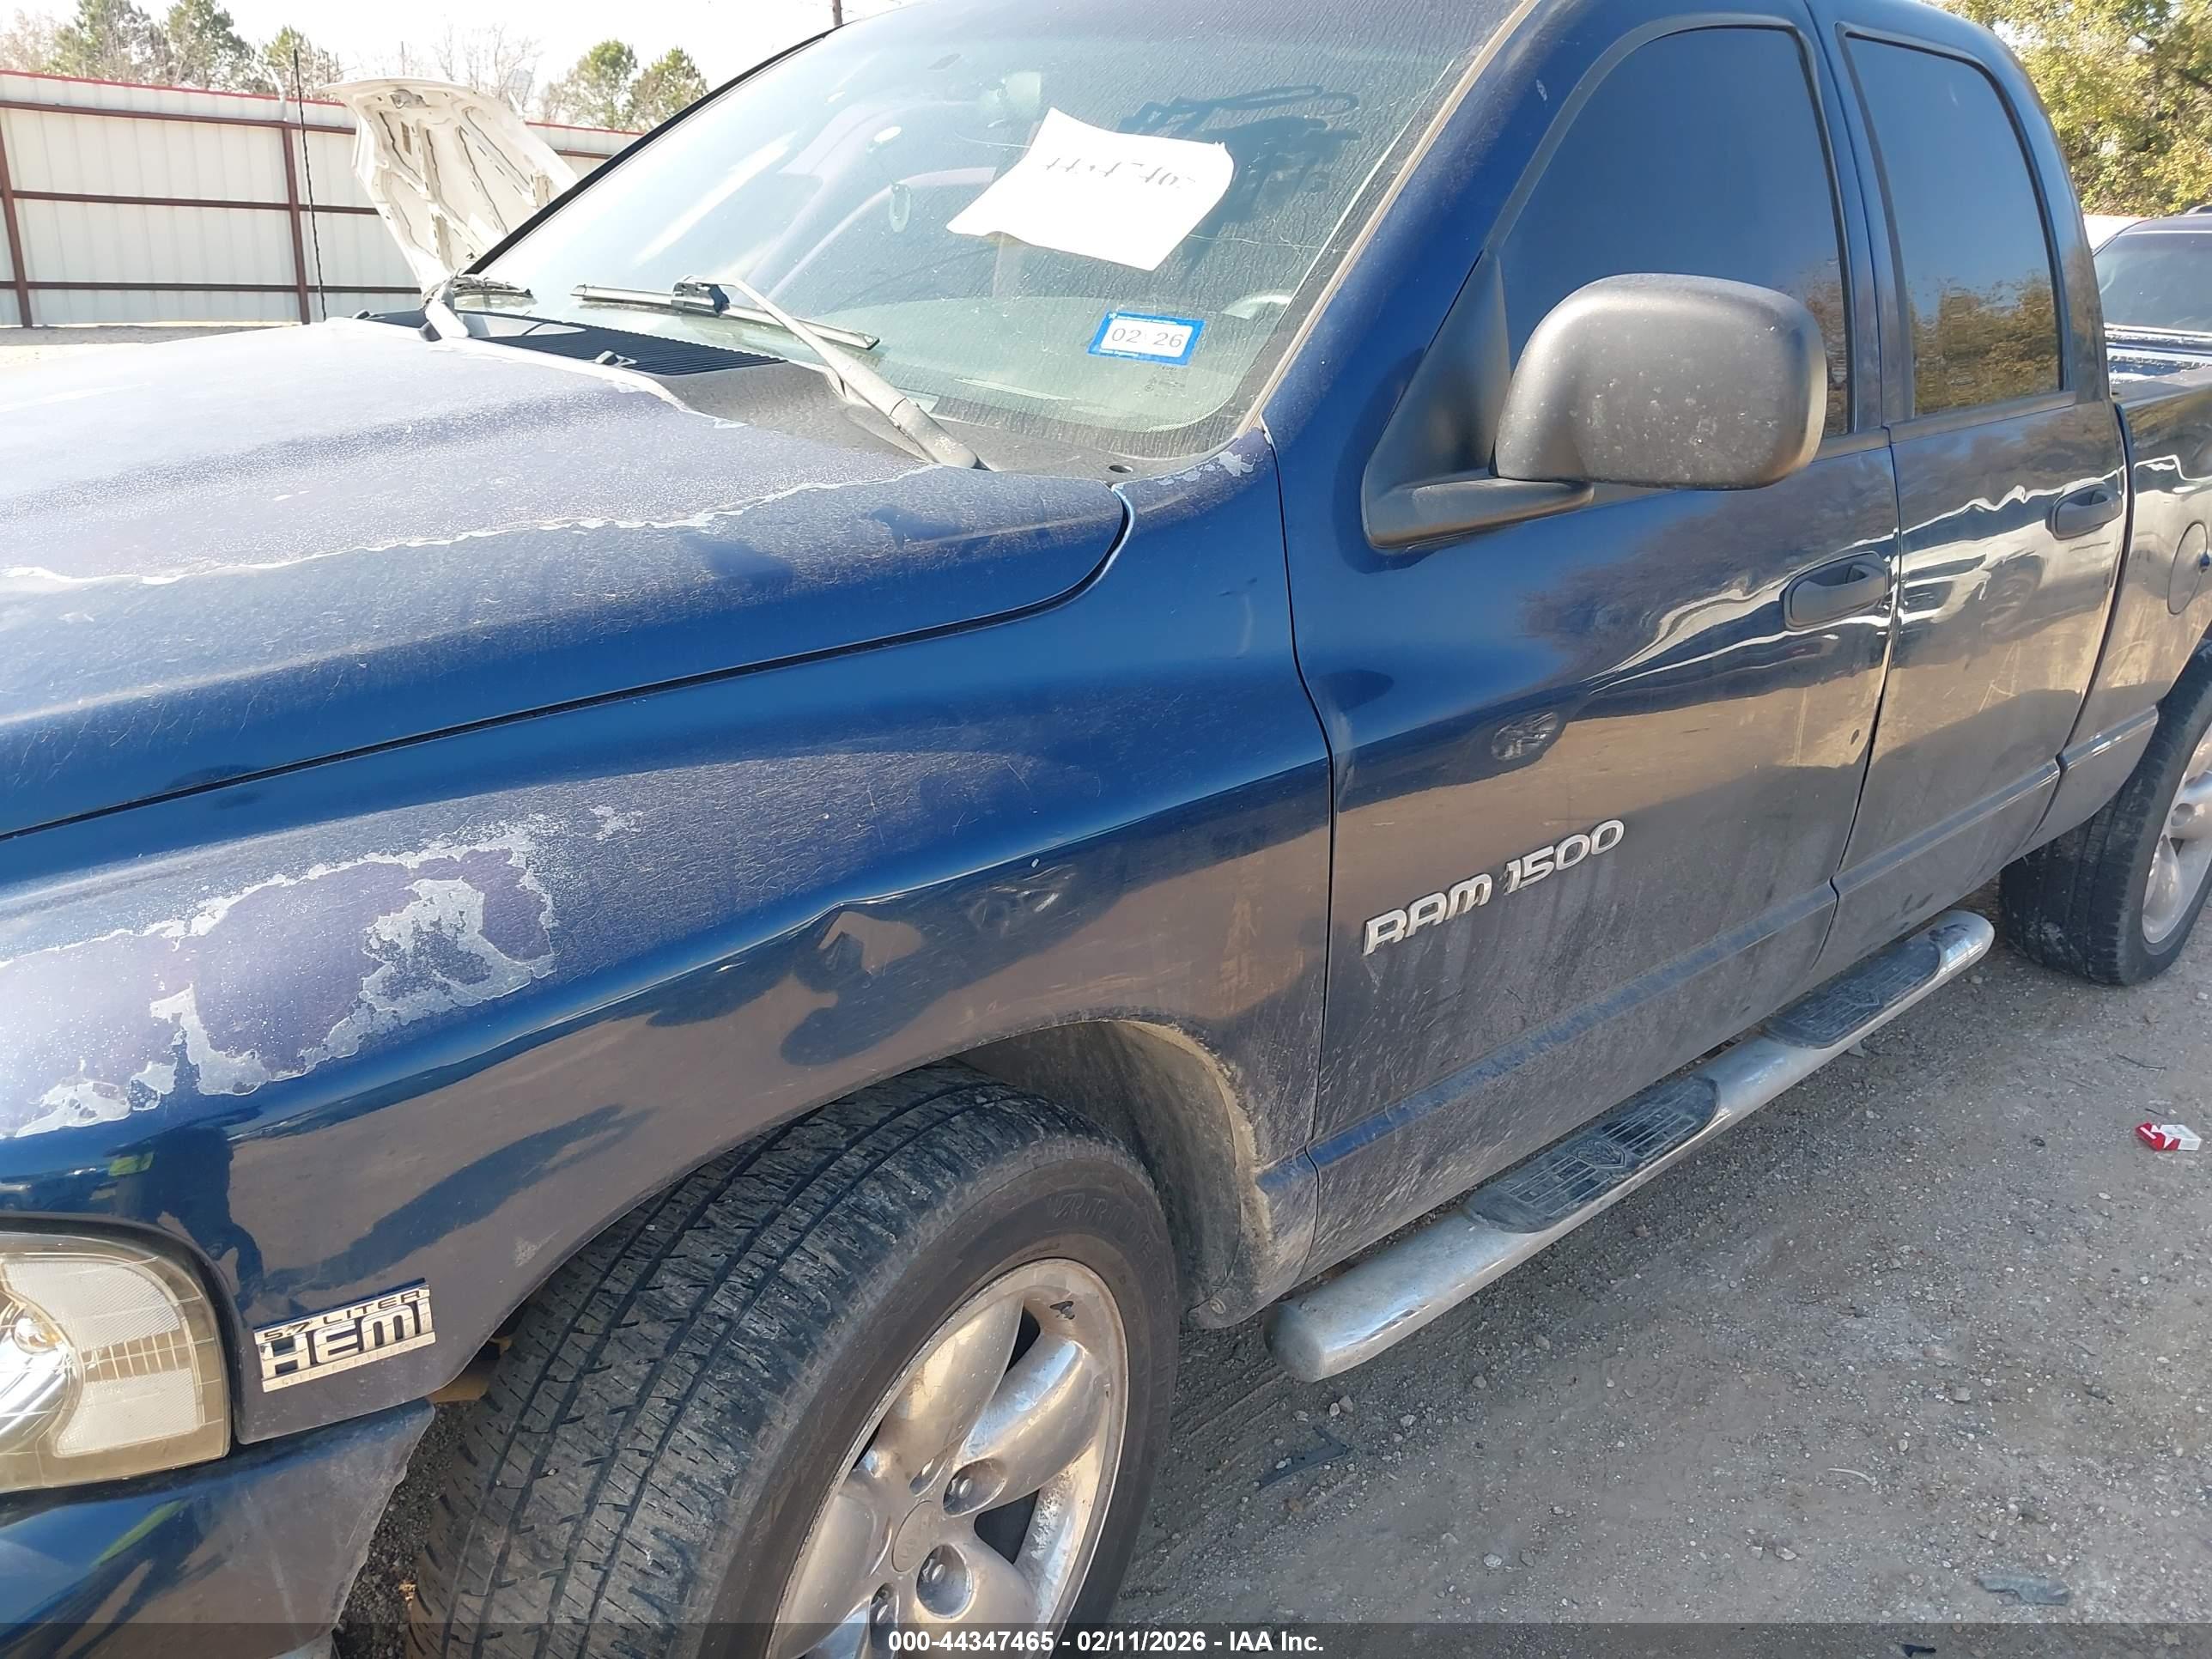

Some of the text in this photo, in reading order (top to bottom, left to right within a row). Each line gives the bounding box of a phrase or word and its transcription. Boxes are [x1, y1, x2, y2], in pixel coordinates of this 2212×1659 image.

[1111, 327, 1184, 349] 02 26
[1363, 819, 1625, 957] RAM 1500
[323, 1289, 421, 1325] LITER
[259, 1297, 433, 1379] HEMI
